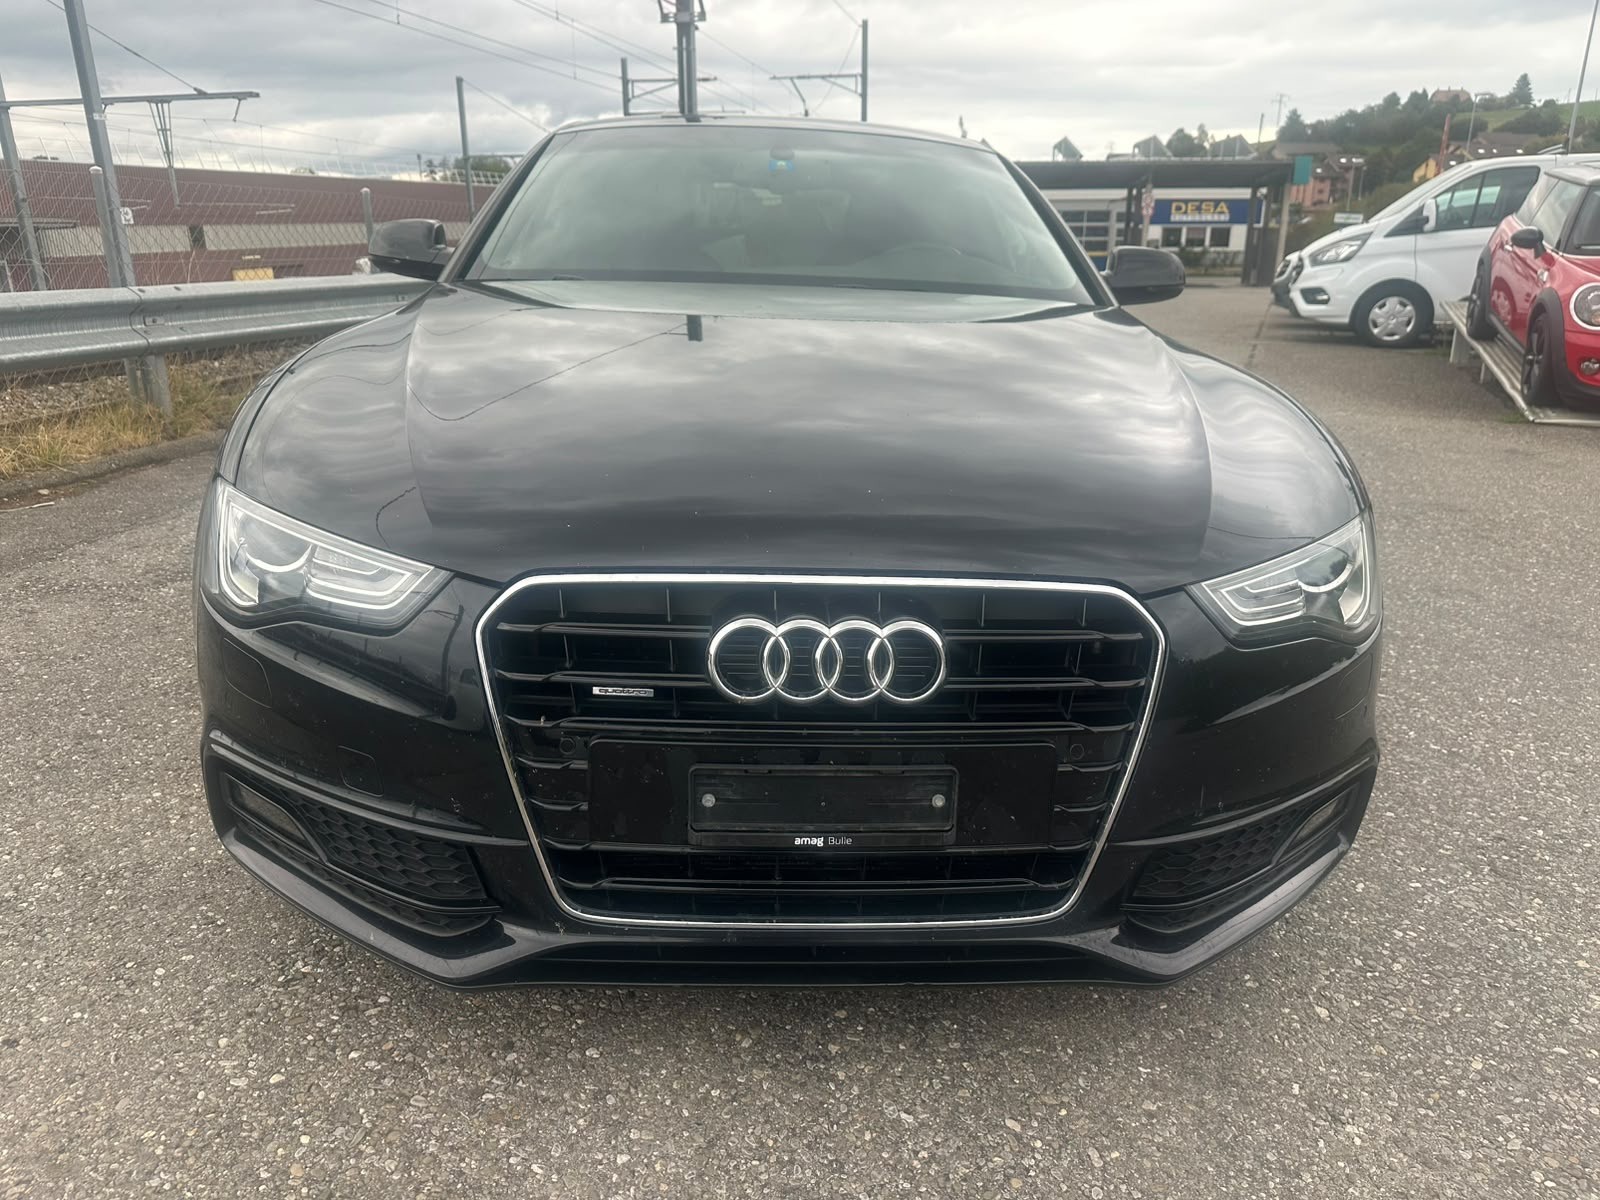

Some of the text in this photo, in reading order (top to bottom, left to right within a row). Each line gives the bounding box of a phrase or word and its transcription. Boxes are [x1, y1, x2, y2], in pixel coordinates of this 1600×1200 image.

[1171, 201, 1229, 214] DESA
[598, 687, 648, 696] quattro
[794, 836, 824, 847] amag
